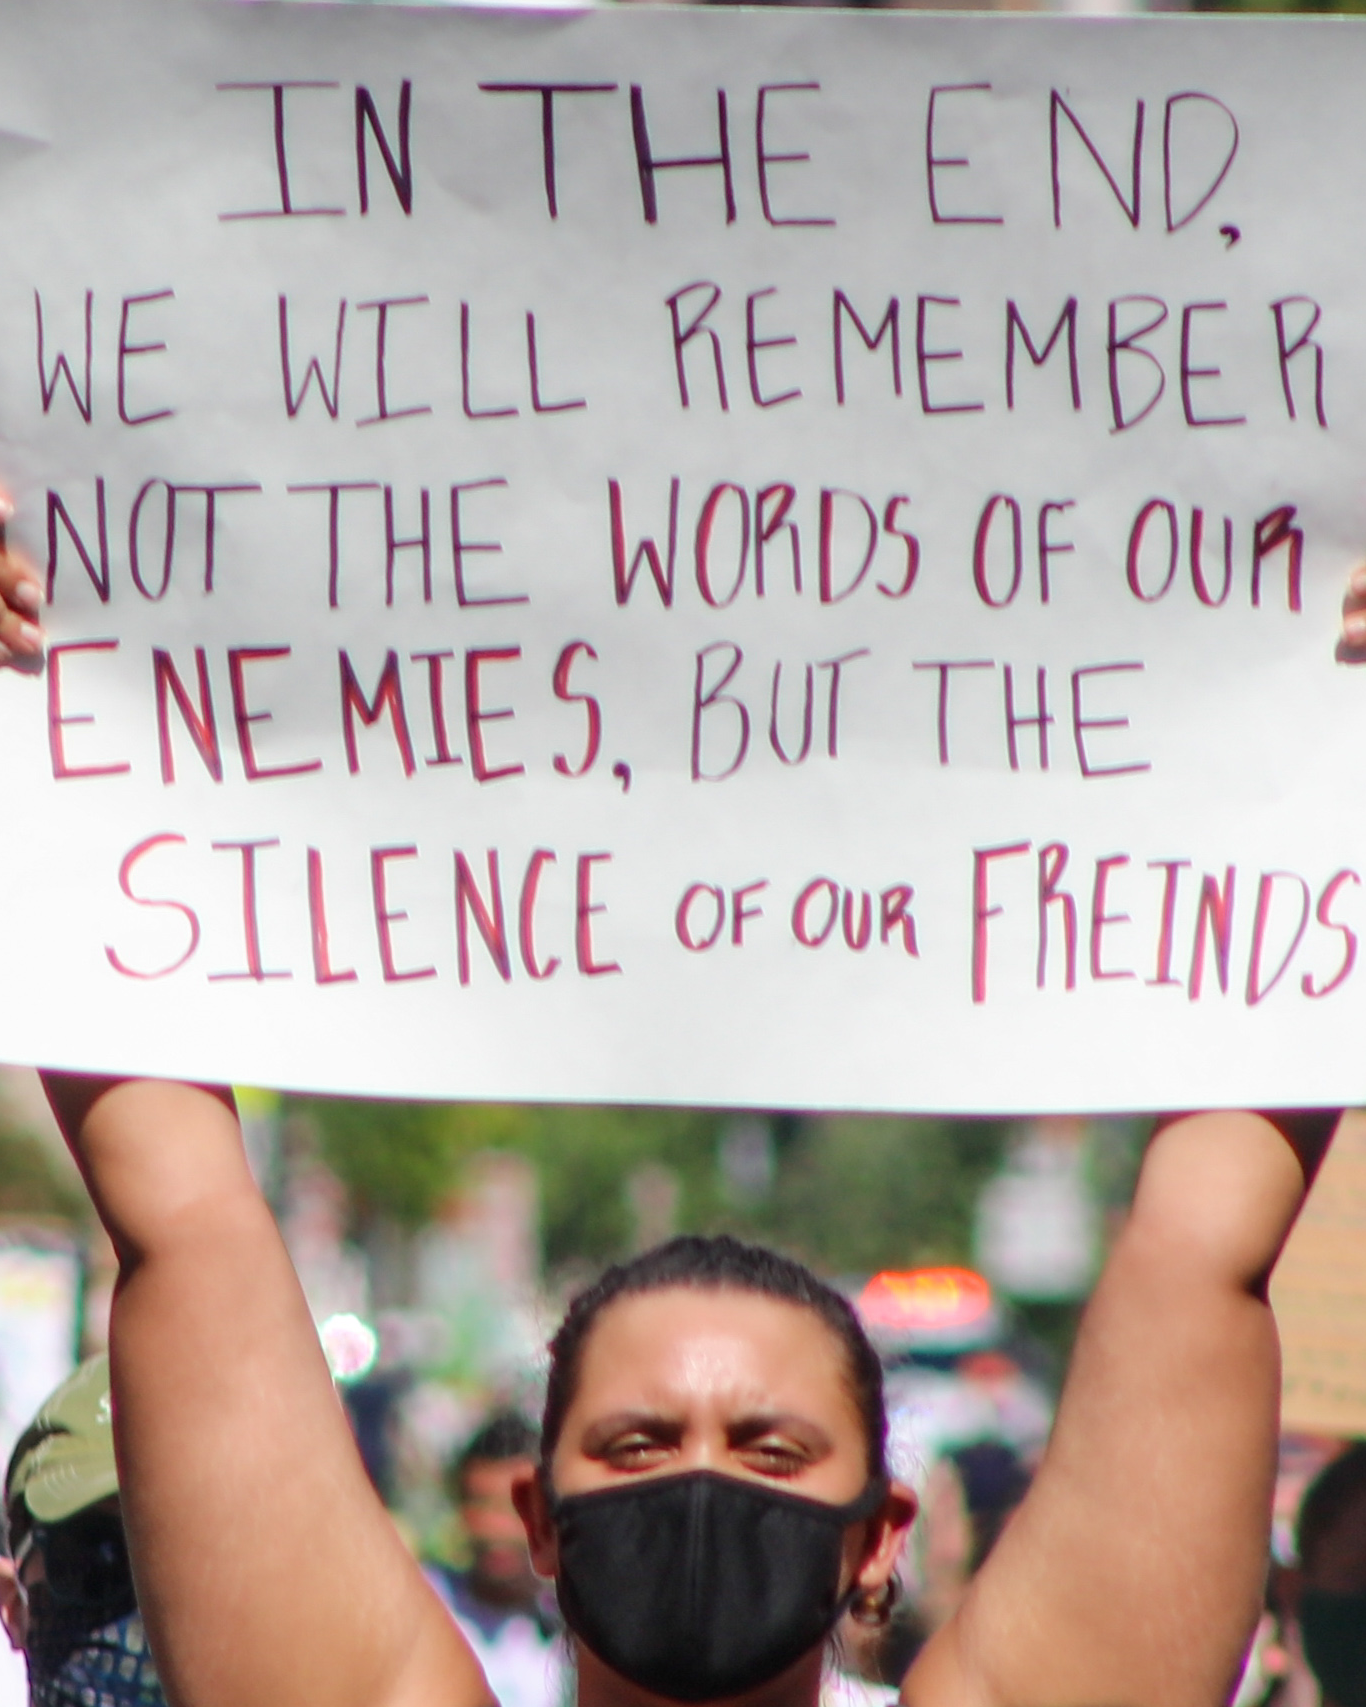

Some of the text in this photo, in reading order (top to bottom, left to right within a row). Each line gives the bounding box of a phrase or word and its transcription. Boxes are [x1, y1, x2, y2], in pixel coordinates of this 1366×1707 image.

[214, 78, 1241, 248] IN THE END,
[34, 281, 1328, 434] WE WILL REMEMBER
[44, 475, 1305, 614] NOT THE WORDS OF OUR
[46, 639, 1152, 793] ENEMIES, BUT THE
[104, 831, 1361, 1009] SILENCE OF OUR FREINDS
